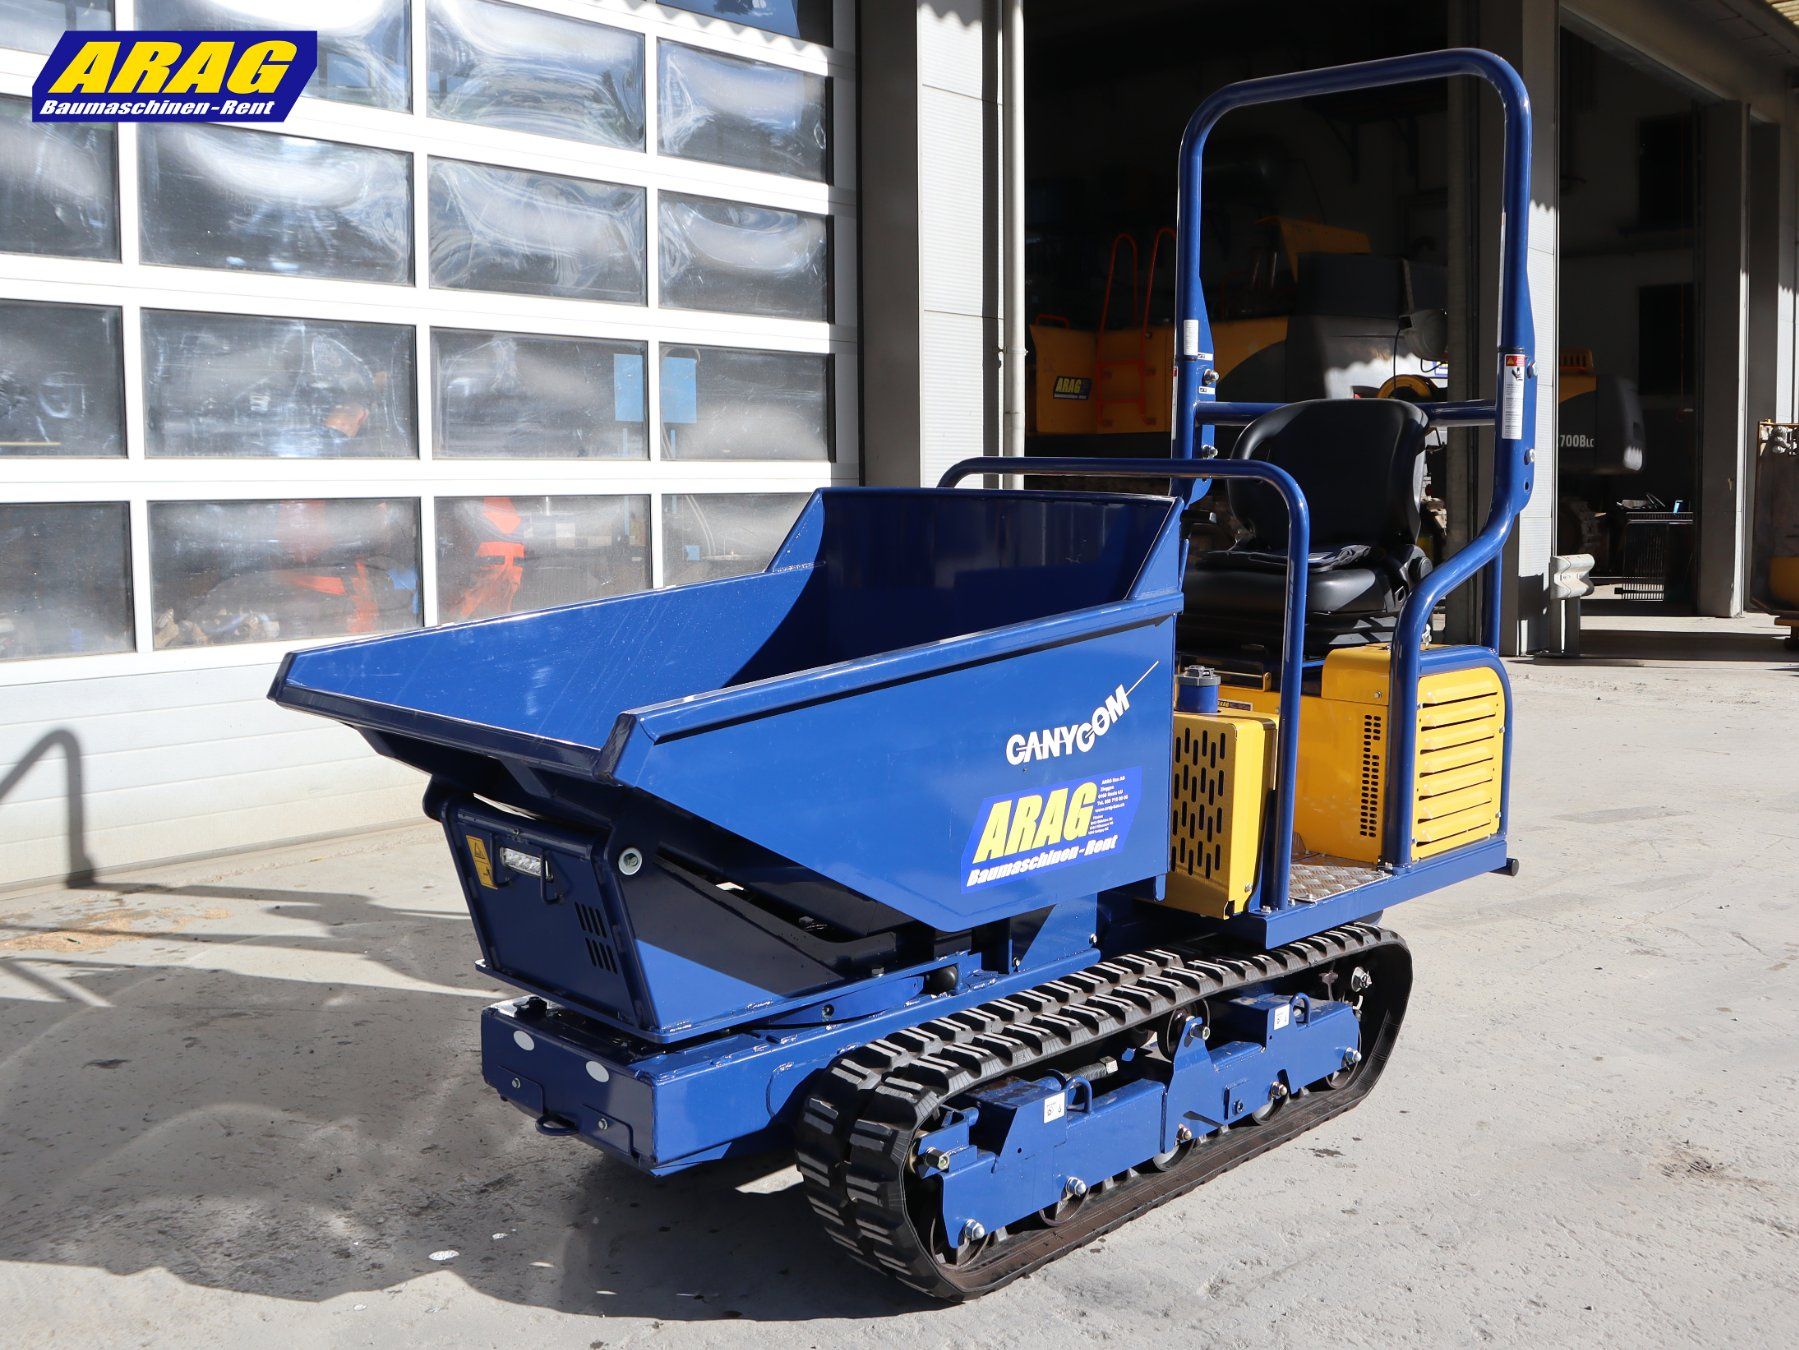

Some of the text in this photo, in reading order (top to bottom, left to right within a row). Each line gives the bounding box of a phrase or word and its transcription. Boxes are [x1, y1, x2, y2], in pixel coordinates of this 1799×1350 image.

[1055, 377, 1082, 394] ARAG
[1006, 684, 1130, 765] CANYCOM
[972, 782, 1098, 864] ARAG
[966, 835, 1119, 887] Baumaschinen-Rent
